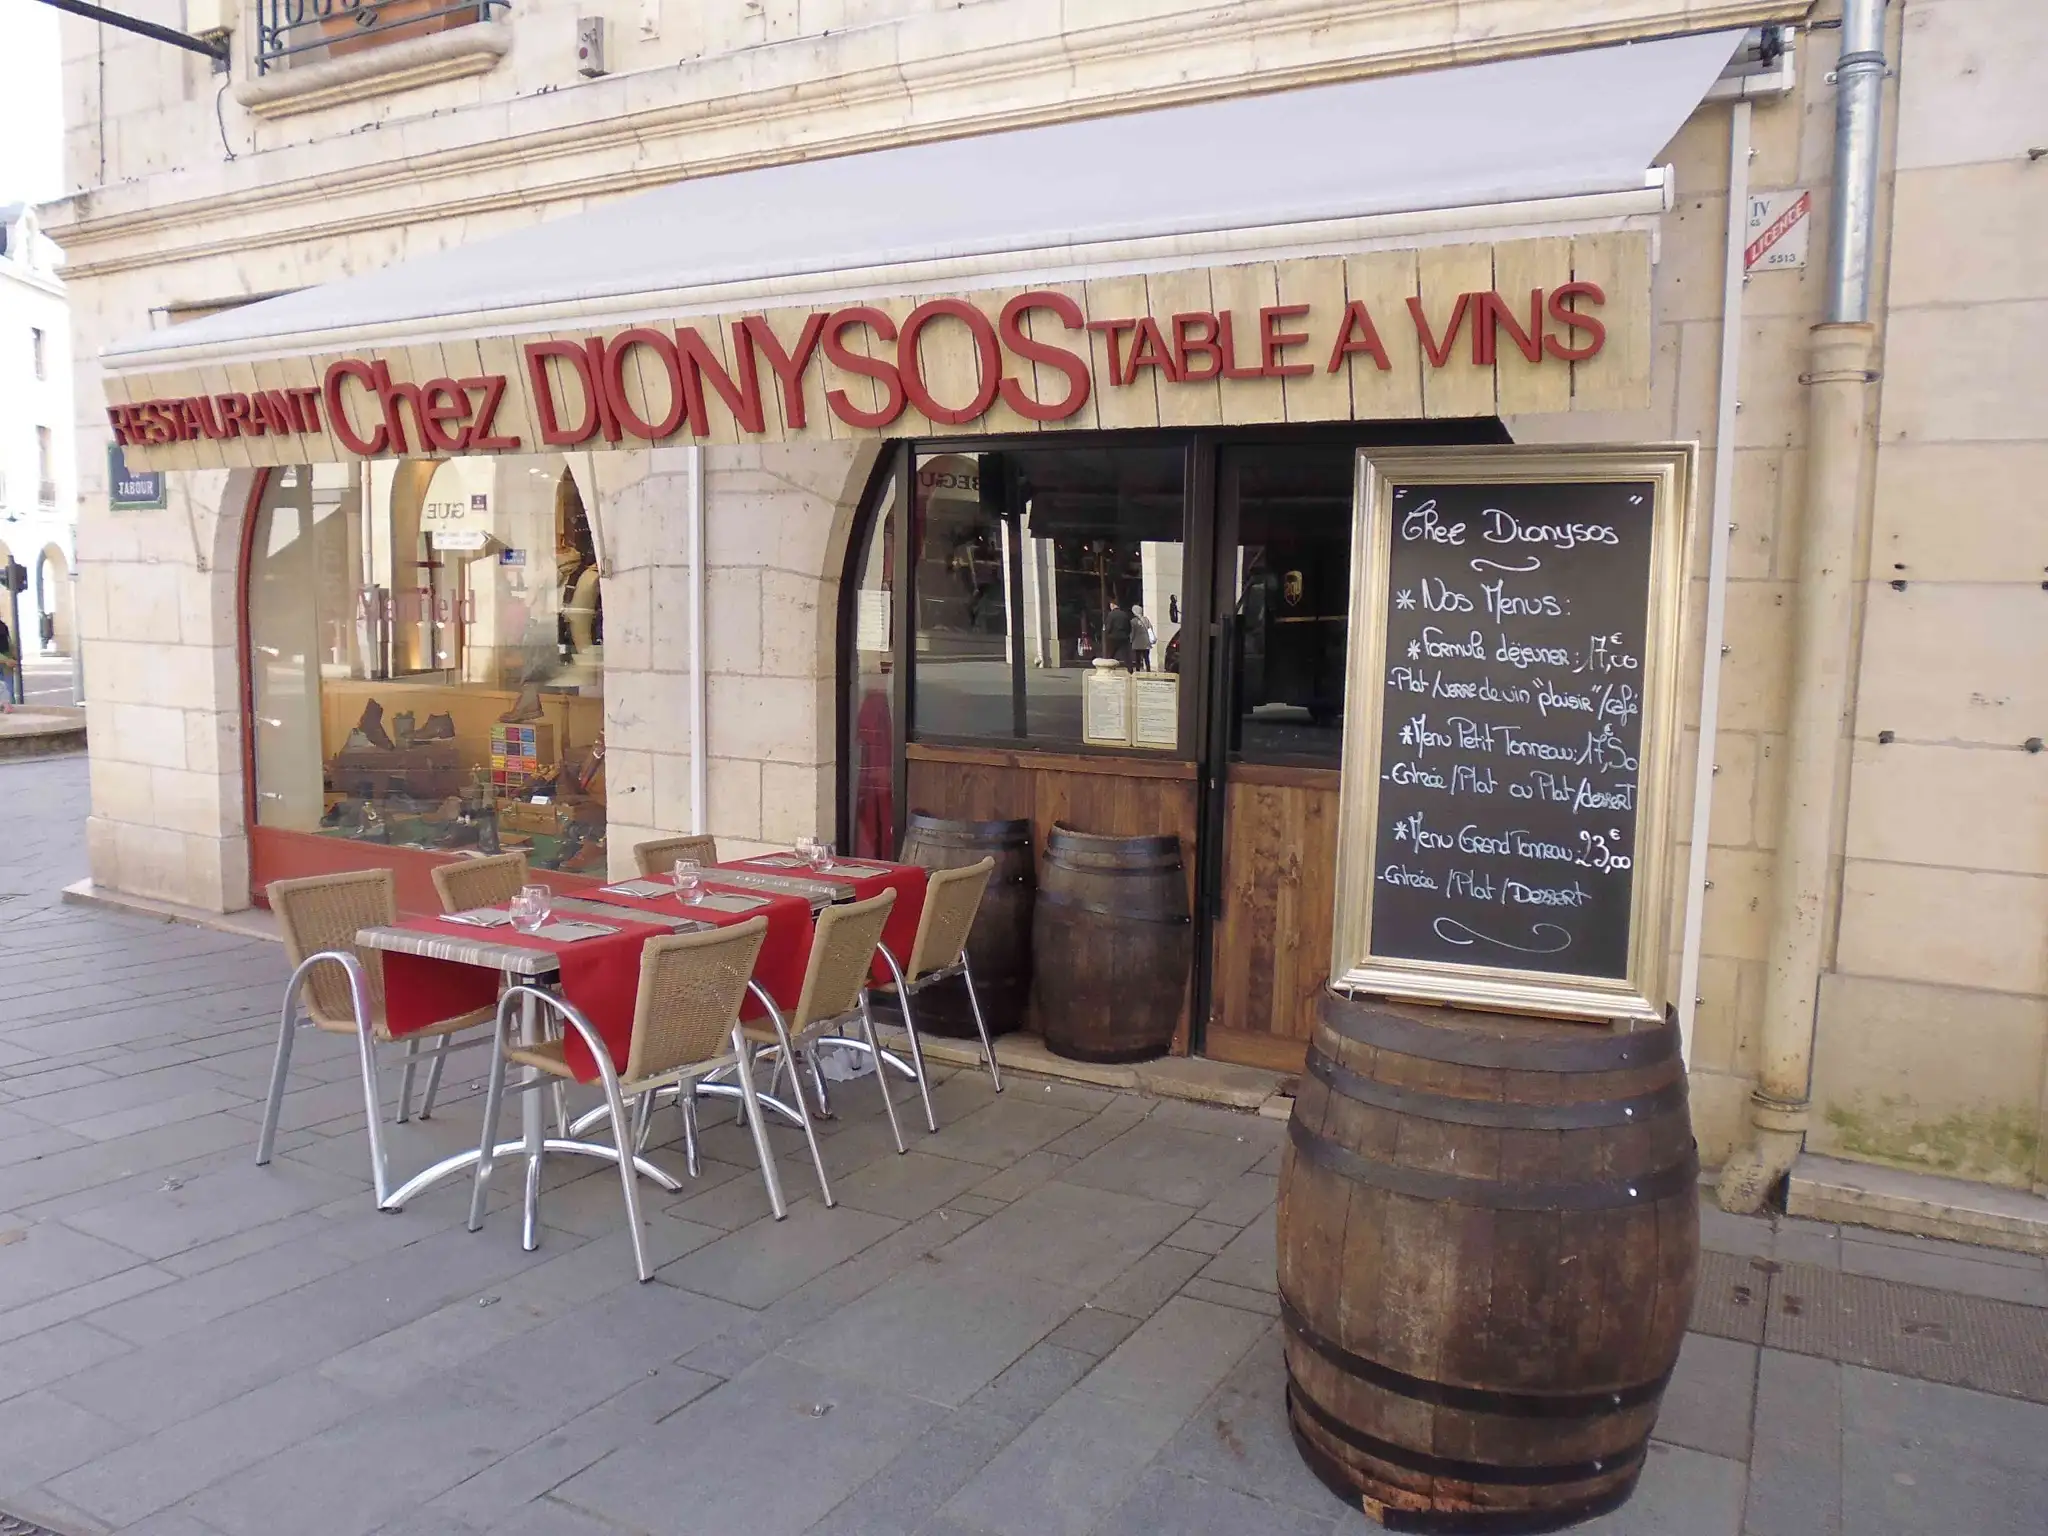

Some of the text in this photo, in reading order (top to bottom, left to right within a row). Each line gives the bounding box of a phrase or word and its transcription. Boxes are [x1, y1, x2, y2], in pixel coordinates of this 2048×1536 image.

[1753, 201, 1770, 217] IV
[1751, 200, 1804, 261] LICENCE
[107, 281, 1606, 456] RESTAURANT Chez DIONYSOS TABLE A VINS
[118, 480, 153, 495] TABOUR
[1482, 509, 1620, 549] Dionysos
[1421, 577, 1474, 612] Nos
[1410, 713, 1452, 759] Menu
[1447, 716, 1495, 752] Petit
[1509, 783, 1533, 799] ou
[1408, 811, 1453, 854] Menu
